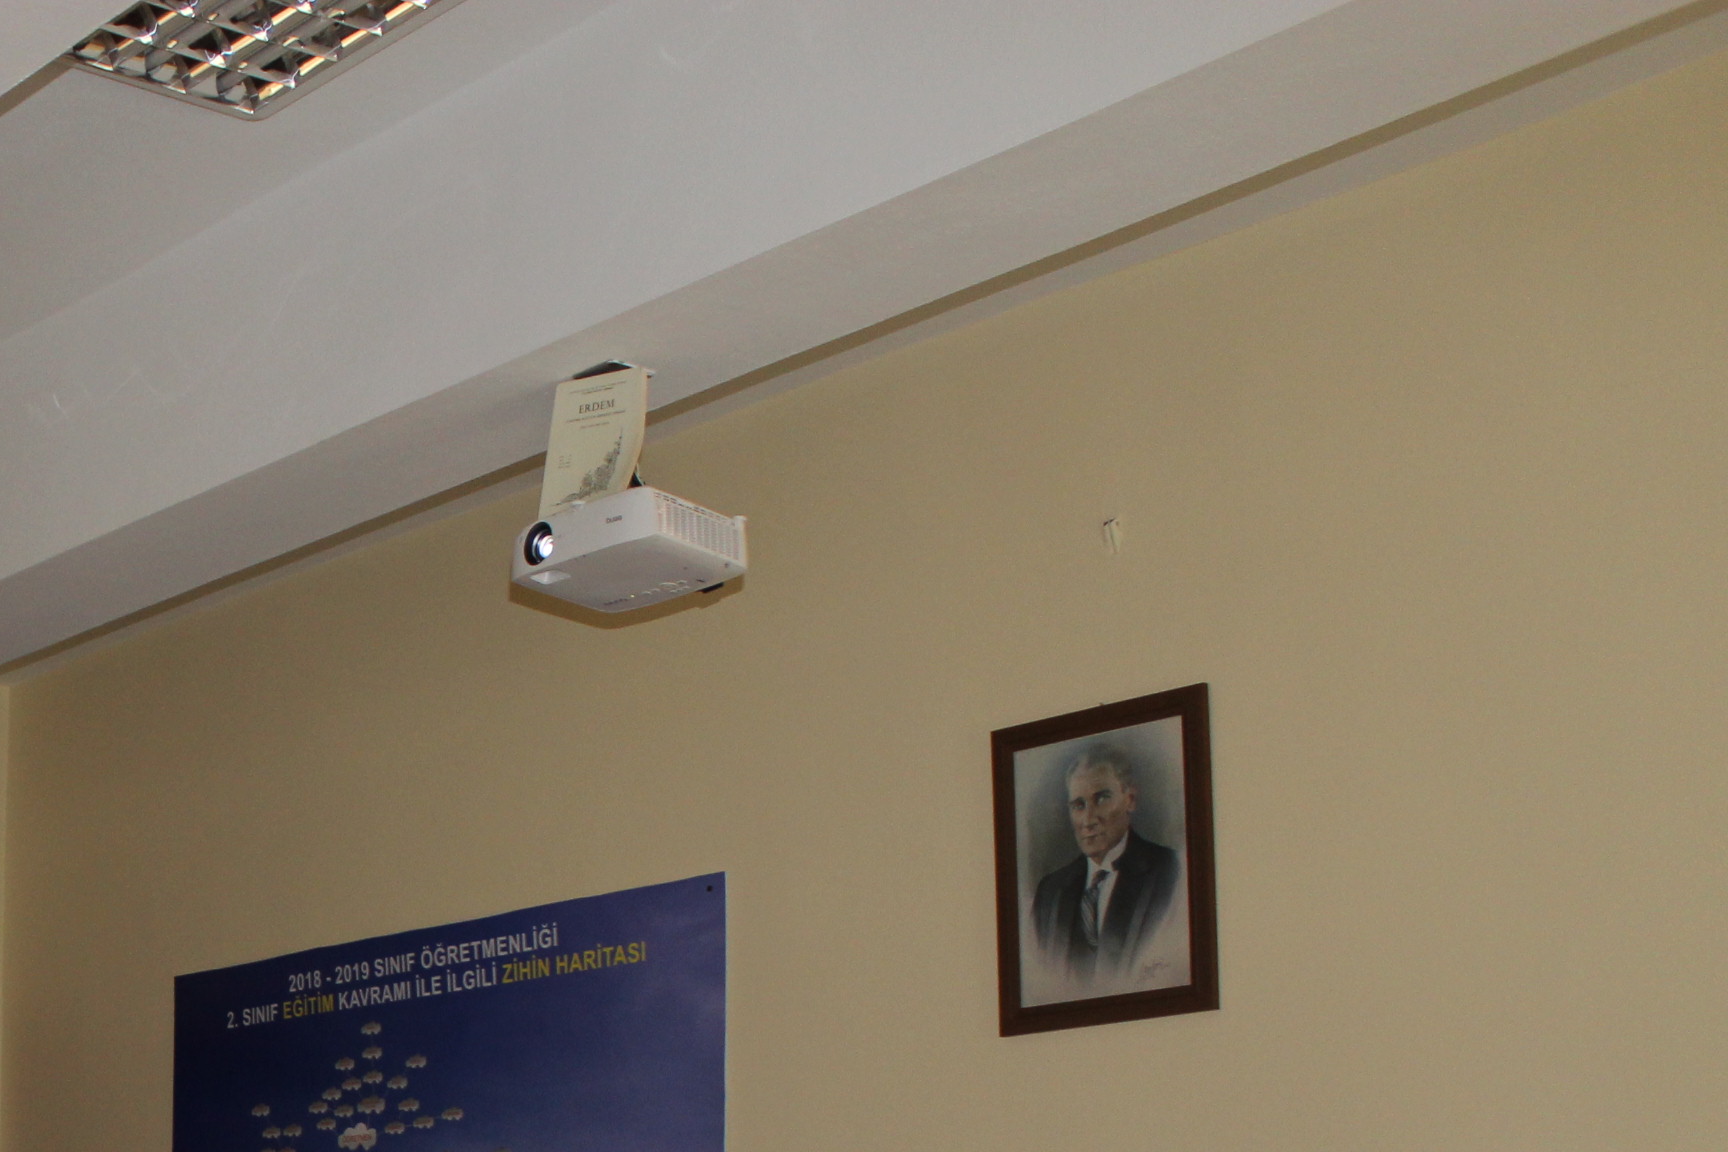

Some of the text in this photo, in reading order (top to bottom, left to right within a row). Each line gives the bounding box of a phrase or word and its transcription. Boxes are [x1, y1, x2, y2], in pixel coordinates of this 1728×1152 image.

[578, 399, 615, 414] ERDEM
[226, 941, 648, 1029] 2. SINIF EĞİTİM KAVRAMI İLE İLGİLİ ZİHİN HARİTASI
[288, 970, 322, 993] 2018
[334, 961, 370, 985] 2019
[374, 952, 416, 978] SINIF
[420, 921, 560, 969] ÖĞRETMENLİĞİ
